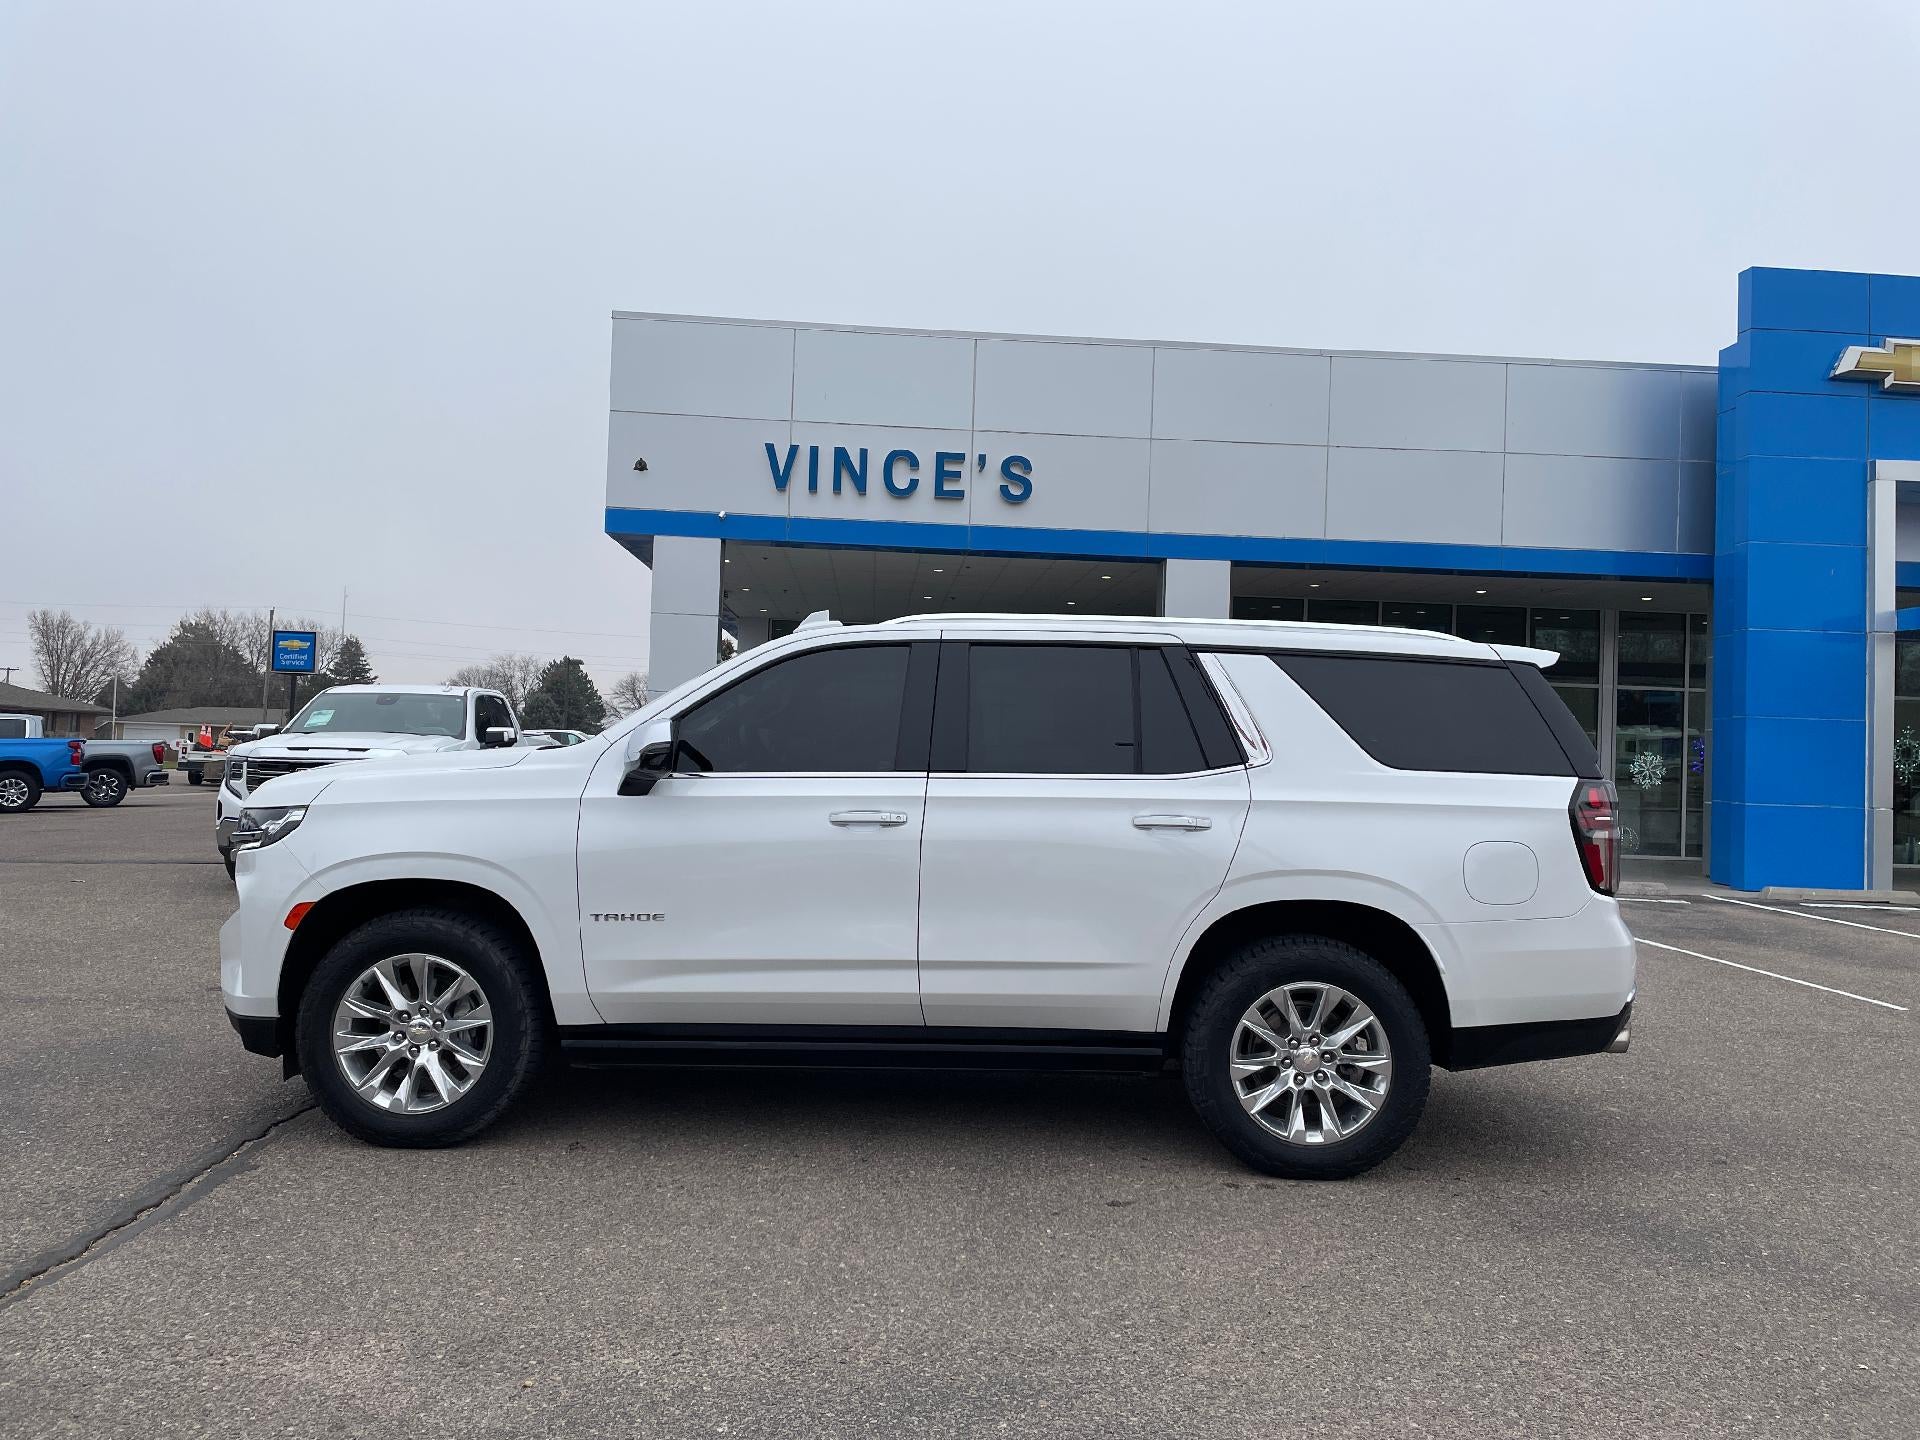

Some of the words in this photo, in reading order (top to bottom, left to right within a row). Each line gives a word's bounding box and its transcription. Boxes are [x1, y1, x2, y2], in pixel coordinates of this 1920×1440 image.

[764, 442, 1033, 504] VINCE'S
[279, 653, 308, 661] Certified
[589, 913, 665, 922] TAHOE
